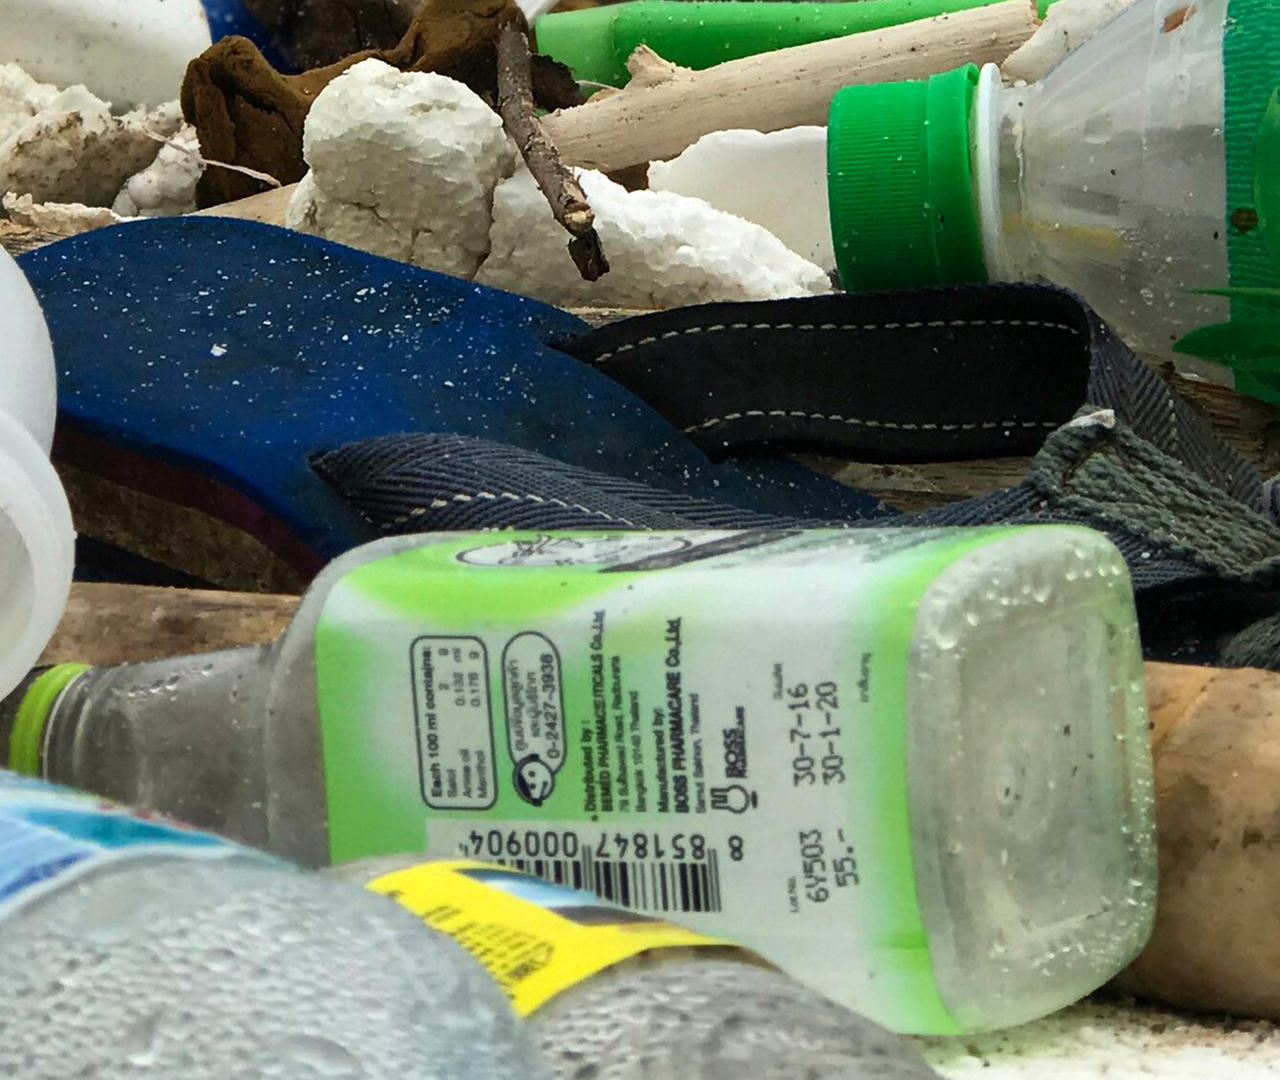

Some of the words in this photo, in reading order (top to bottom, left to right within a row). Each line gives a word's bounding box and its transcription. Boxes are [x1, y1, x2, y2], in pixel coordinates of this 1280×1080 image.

[422, 646, 435, 709] contains:
[427, 713, 436, 730] ml
[540, 654, 560, 759] 0-2427-3938
[591, 654, 610, 767] PHARMACEUTICALS
[628, 691, 640, 731] Thailand
[666, 672, 686, 770] PHARMACARE
[689, 693, 700, 734] Thailand
[428, 734, 438, 757] 100
[581, 728, 592, 742] by
[723, 728, 738, 778] BOSS
[787, 683, 816, 787] 30-7-16
[815, 681, 846, 785] 30-1-20
[429, 763, 442, 797] Each
[475, 750, 487, 798] Menthol
[582, 747, 596, 811] Distributed
[599, 771, 613, 811] BEMED
[635, 770, 647, 812] Bangkok
[653, 730, 668, 812] Manufactured
[674, 776, 689, 813] BOSS
[468, 831, 578, 857] 000904
[595, 832, 705, 859] 851847
[727, 836, 744, 862] 8
[799, 829, 829, 903] 6Y503
[789, 895, 799, 912] Lot
